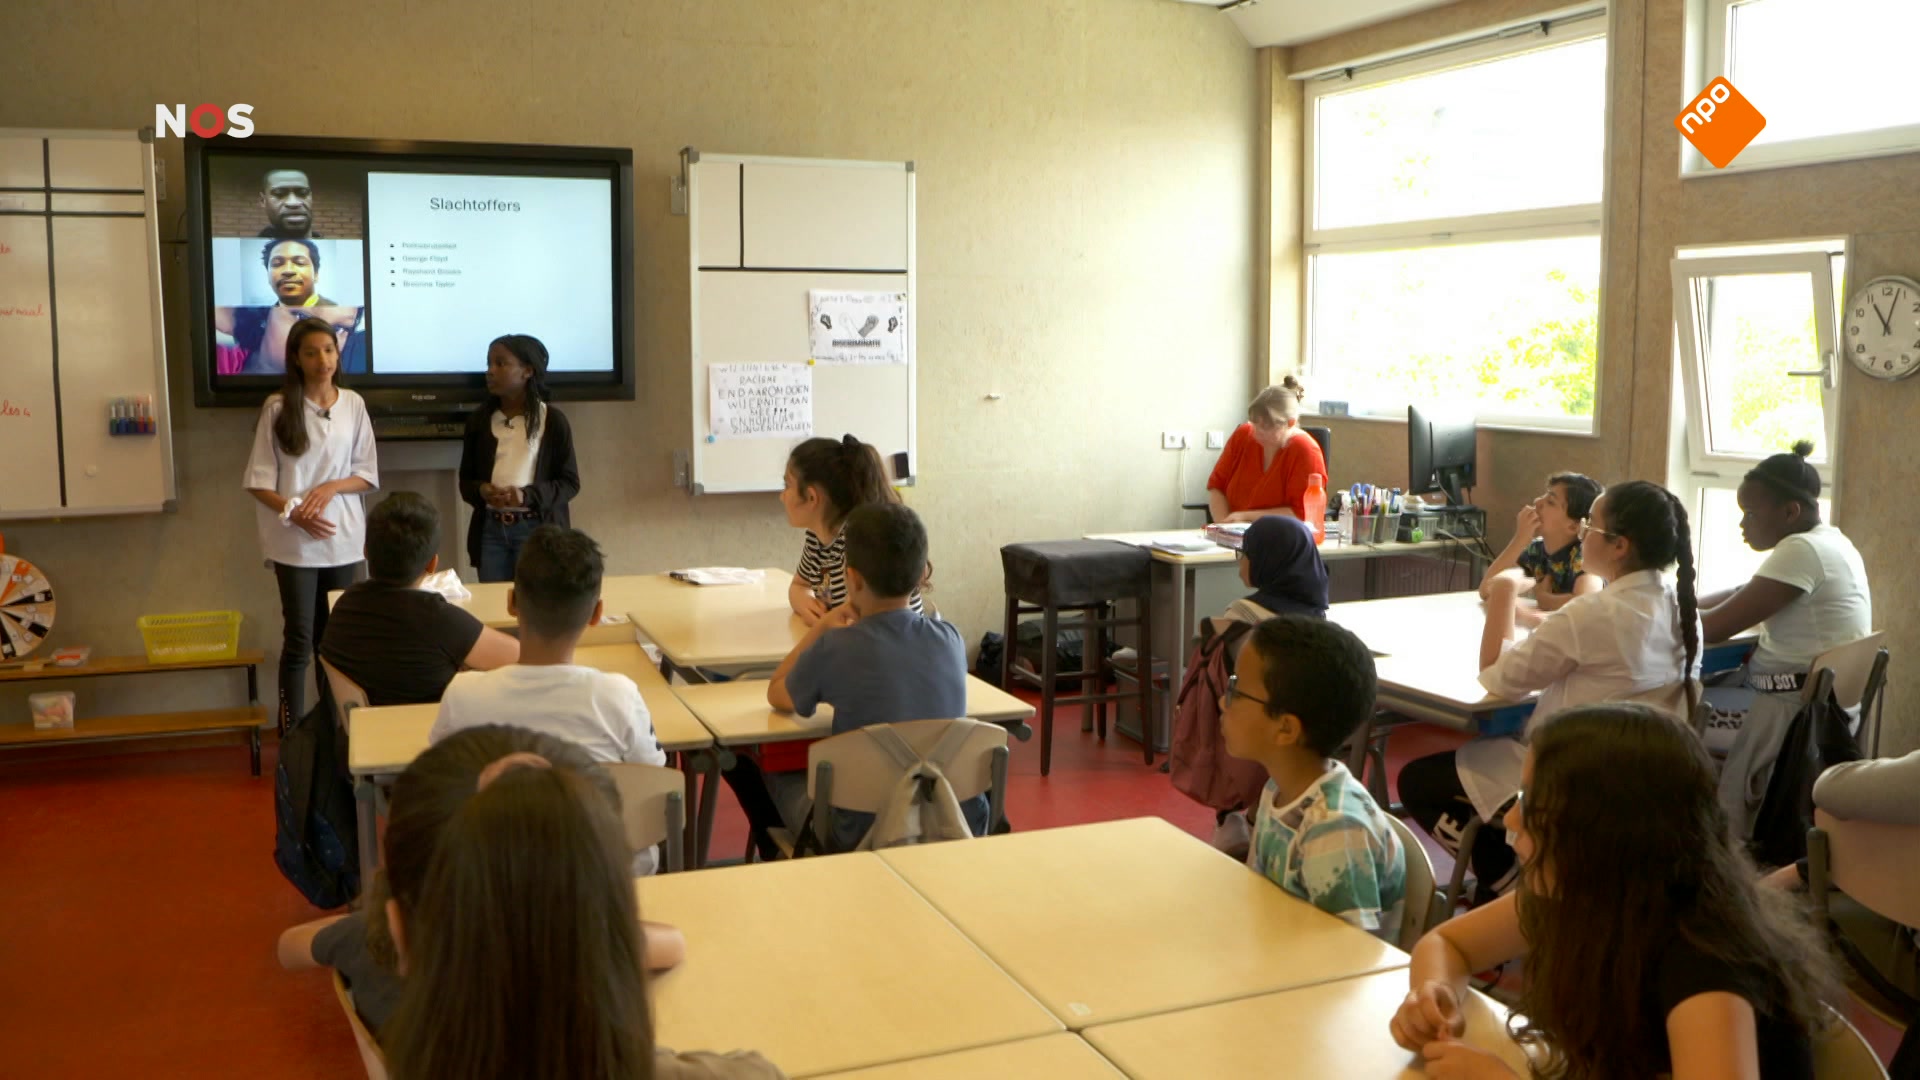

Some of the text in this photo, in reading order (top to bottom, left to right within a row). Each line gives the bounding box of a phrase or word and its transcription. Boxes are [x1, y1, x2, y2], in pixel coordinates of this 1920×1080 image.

[430, 196, 521, 212] Slachtoffers
[1882, 287, 1893, 296] 12
[1867, 294, 1874, 304] 11
[1855, 308, 1865, 318] 10
[1851, 325, 1860, 336] 9
[1856, 343, 1866, 354] 8
[1869, 356, 1877, 367] 7
[1884, 360, 1894, 371] 6
[739, 375, 777, 385] RACISME
